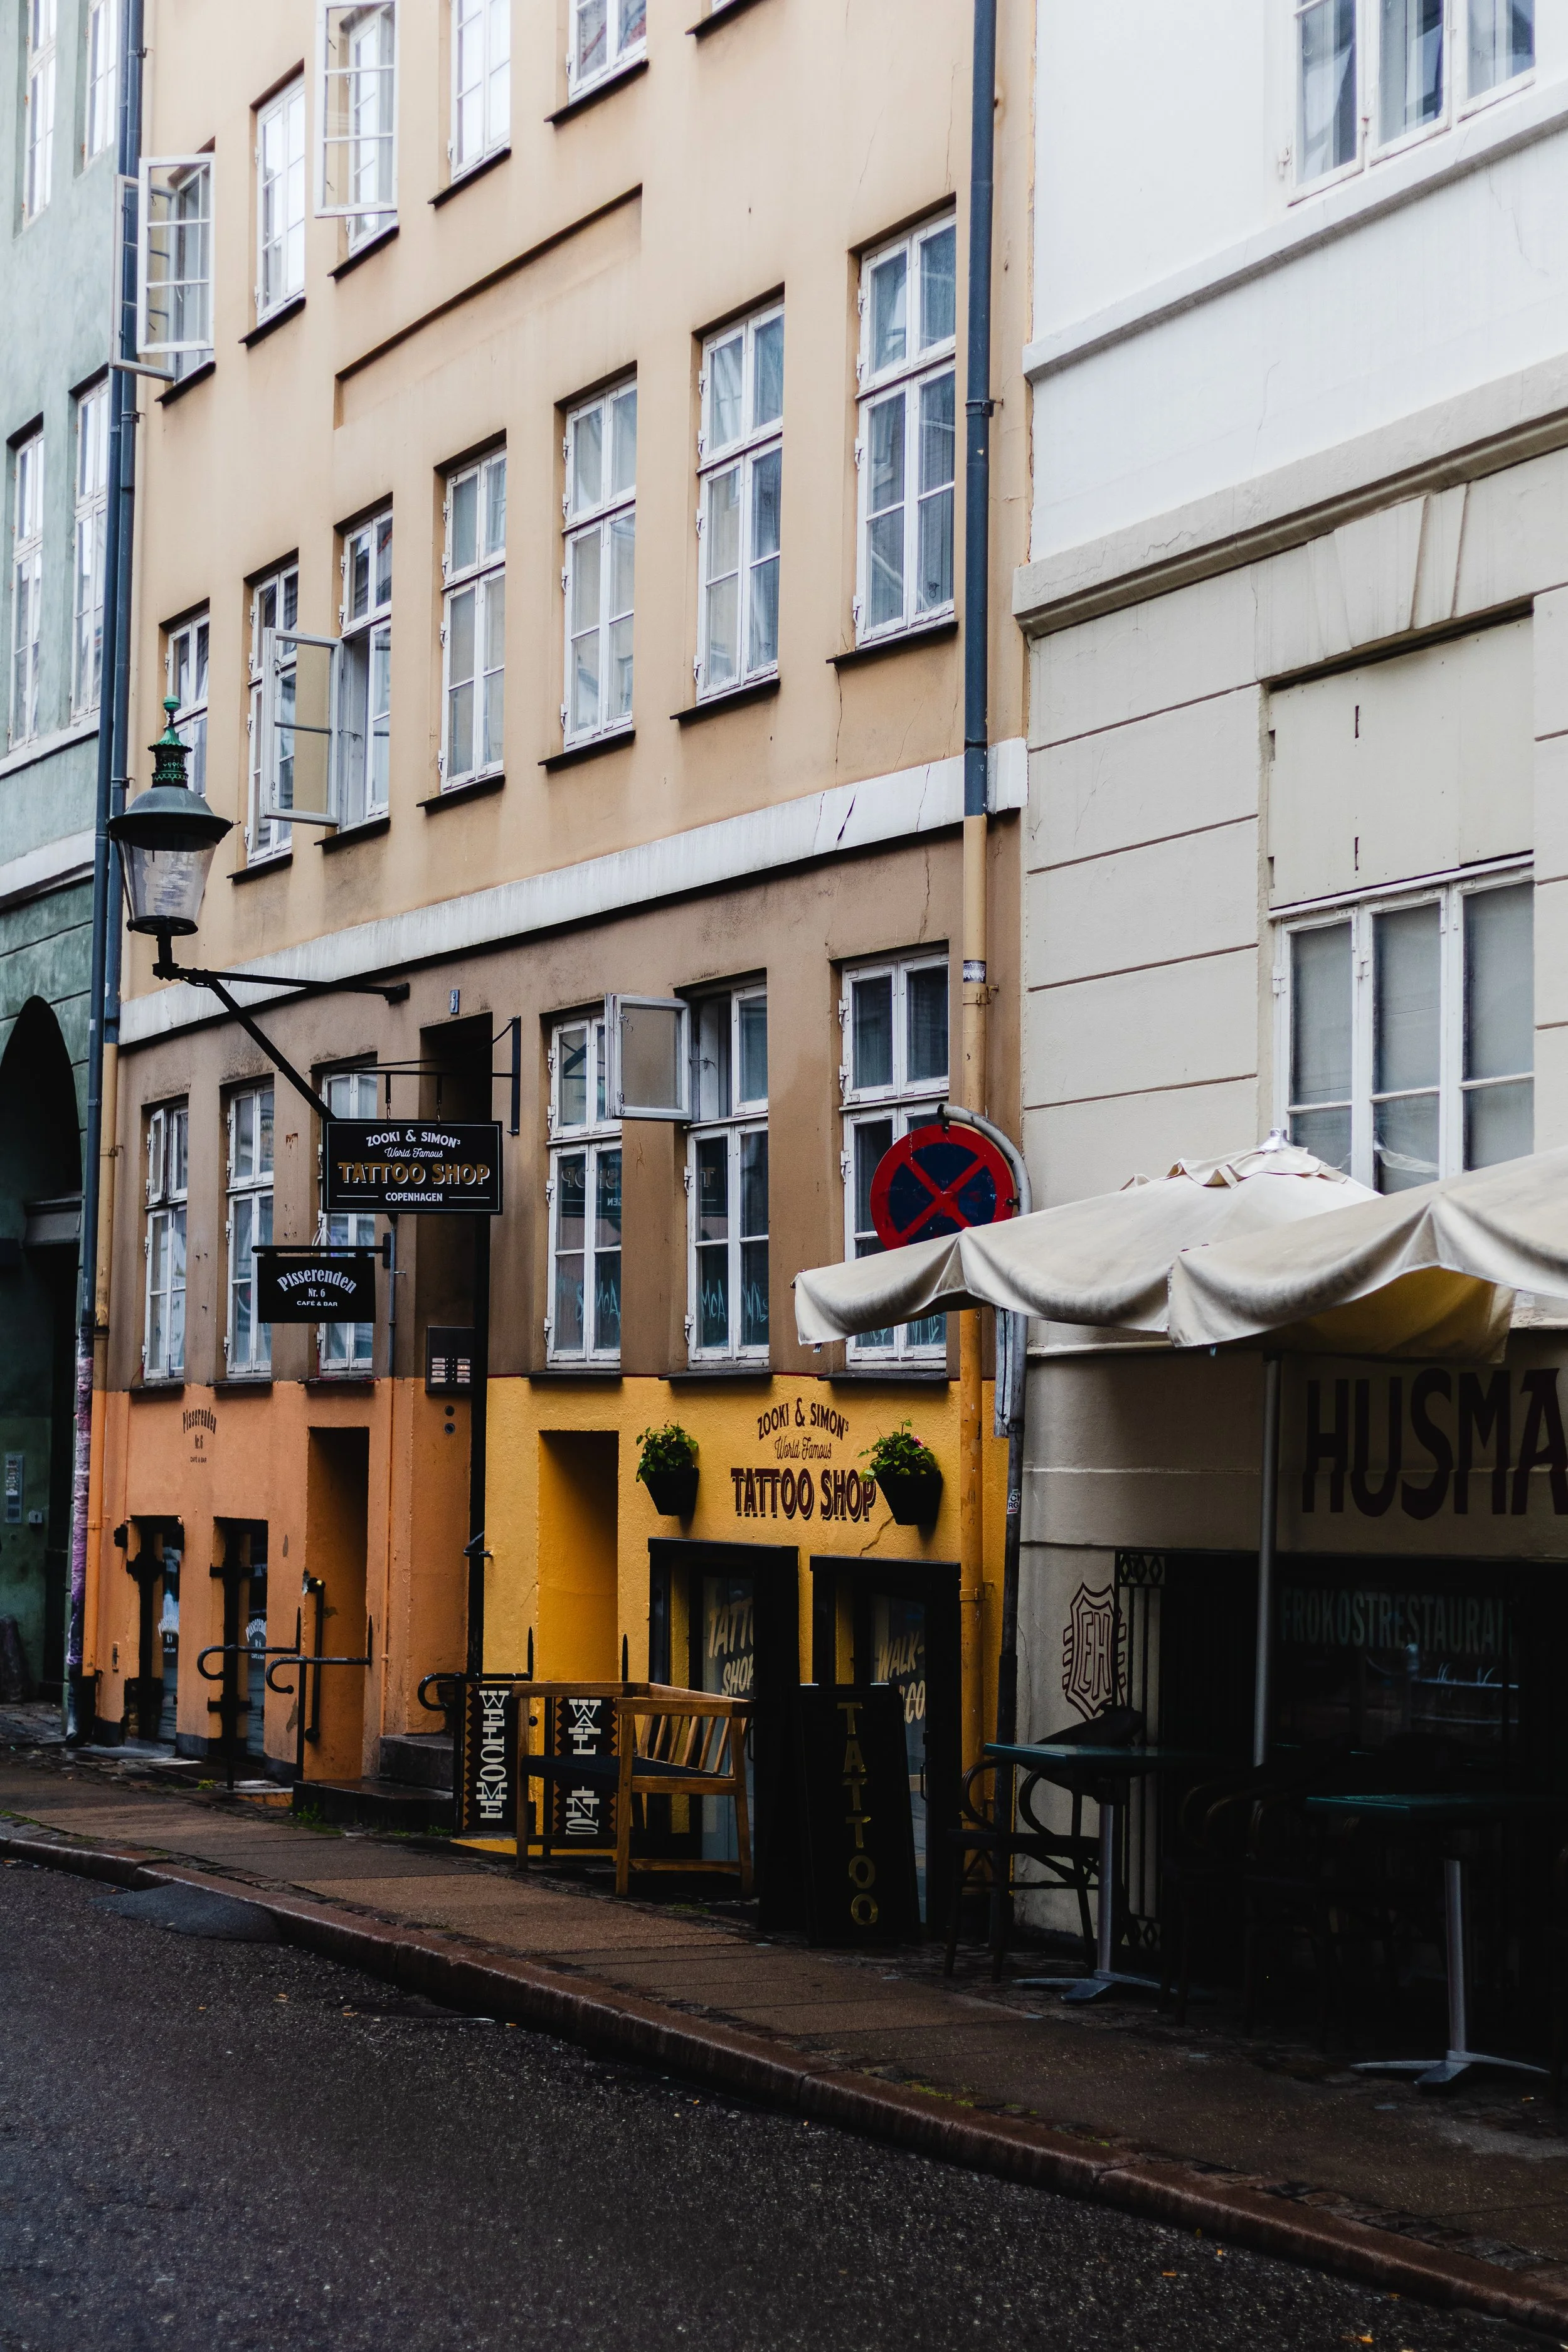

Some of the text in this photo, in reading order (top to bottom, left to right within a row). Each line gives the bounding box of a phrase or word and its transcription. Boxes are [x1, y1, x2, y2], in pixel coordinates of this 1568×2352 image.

[451, 992, 456, 1010] 6
[366, 1131, 400, 1147] ZOOKI
[405, 1129, 416, 1142] &
[384, 1147, 443, 1158] World Famous
[337, 1162, 490, 1185] TATTOO SHOP
[385, 1192, 443, 1202] COPENHAGEN
[277, 1269, 357, 1294] Pisserenden
[308, 1288, 326, 1298] Nr. 6
[183, 1406, 216, 1435] Pisserenden
[757, 1402, 789, 1441] ZOOKI
[795, 1397, 805, 1427] &
[774, 1436, 832, 1460] World Famous
[1302, 1367, 1568, 1520] HUSMA
[731, 1468, 877, 1523] TATTOO SHOP
[475, 1690, 509, 1819] WELCOME
[836, 1702, 879, 1926] TATTOO
